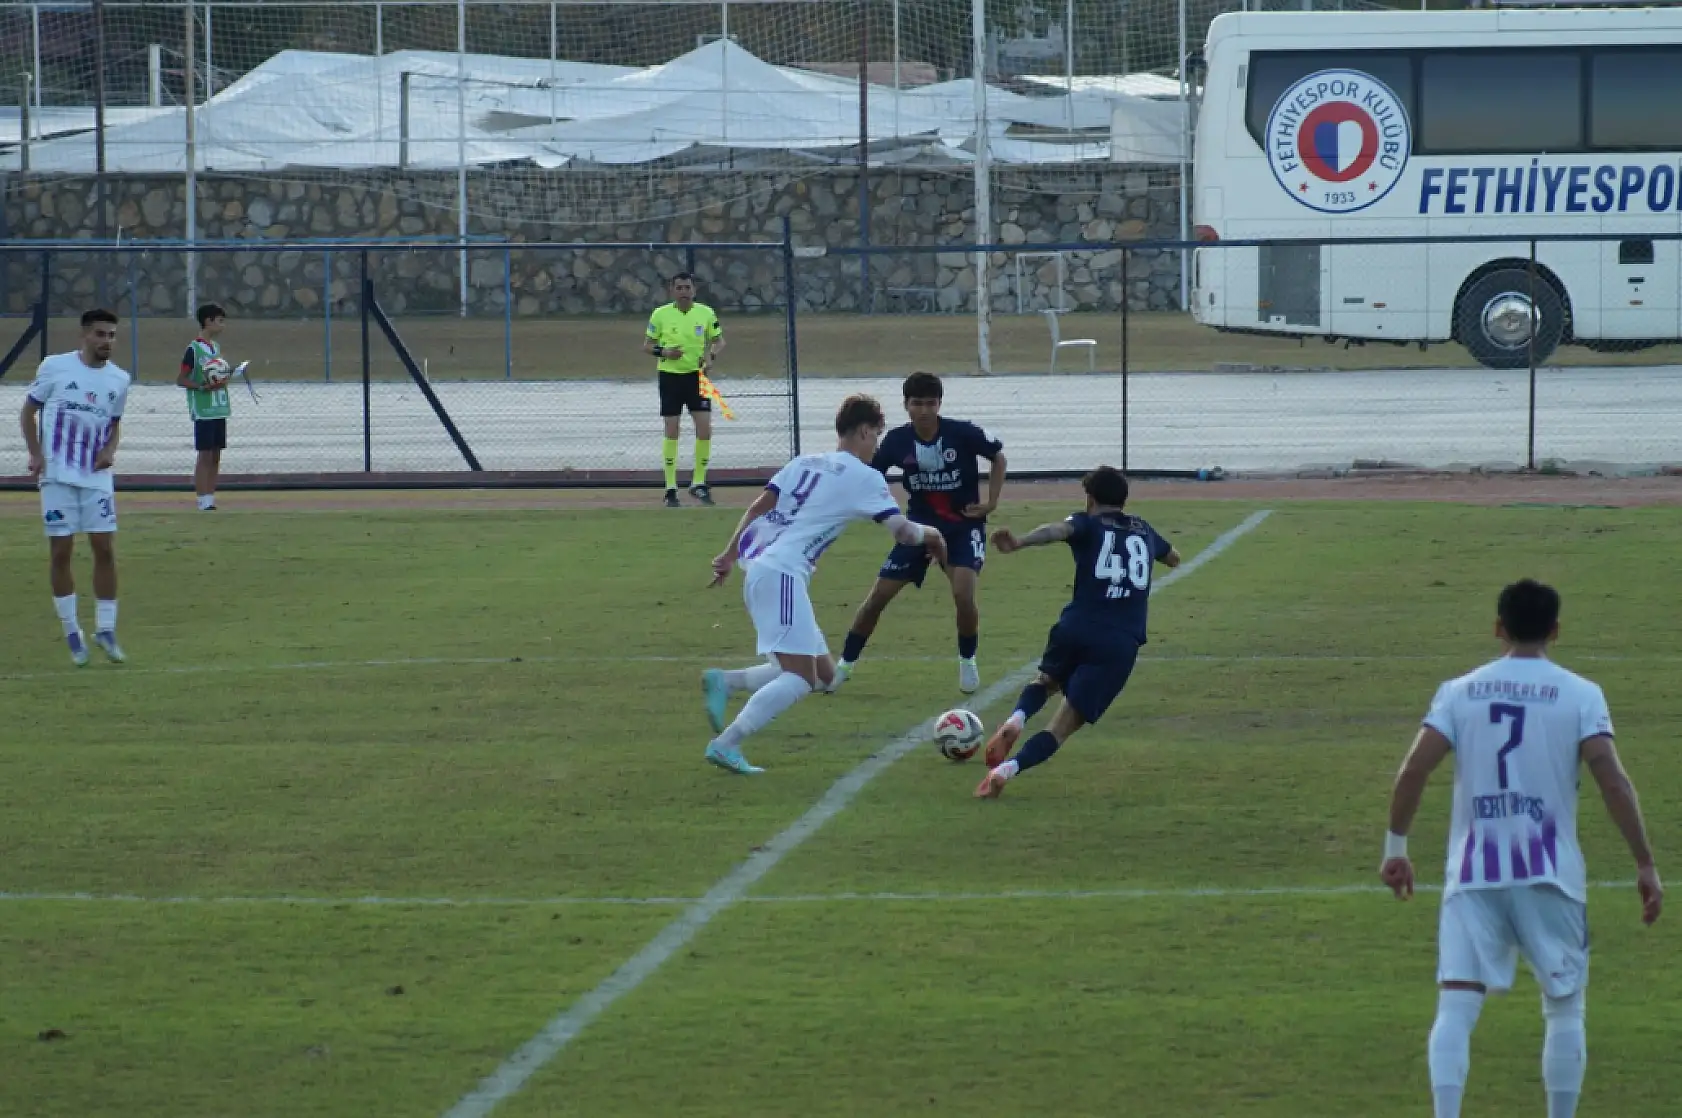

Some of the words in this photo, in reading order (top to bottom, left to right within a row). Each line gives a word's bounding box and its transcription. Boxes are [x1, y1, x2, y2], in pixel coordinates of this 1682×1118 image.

[1276, 80, 1359, 173] FETHİYESPOR
[1362, 90, 1404, 170] KULÜBÜ
[1324, 192, 1356, 204] 1933
[1418, 157, 1682, 214] FETHİYESPO
[791, 470, 822, 516] 4
[1095, 530, 1149, 590] 48
[1490, 702, 1525, 789] 7
